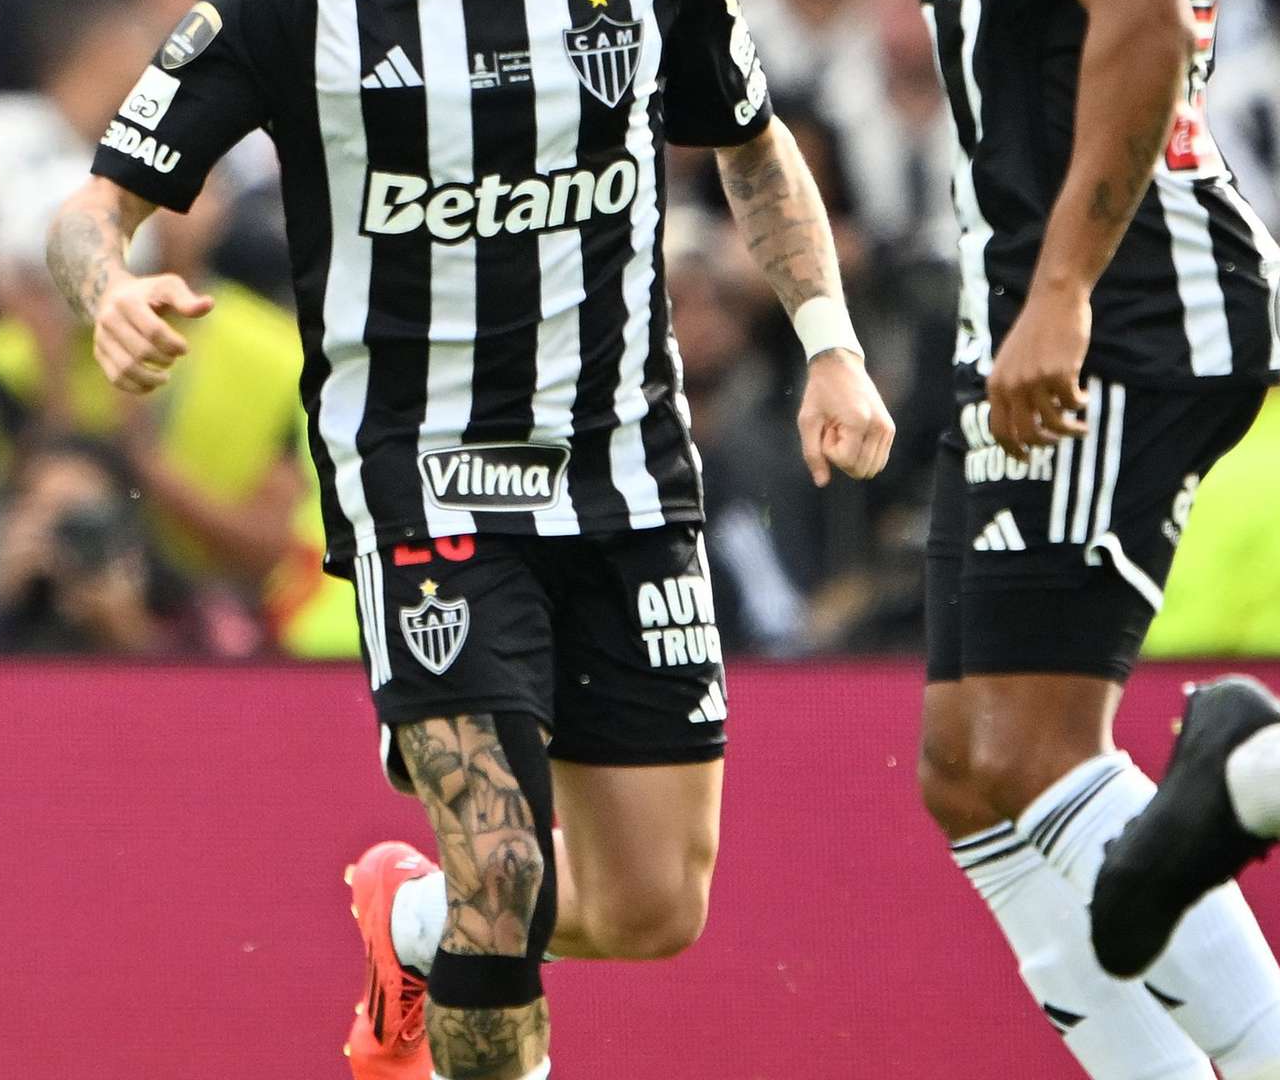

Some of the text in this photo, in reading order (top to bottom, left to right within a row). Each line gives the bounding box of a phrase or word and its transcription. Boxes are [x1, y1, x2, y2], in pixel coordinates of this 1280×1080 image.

[575, 29, 633, 51] CAM
[101, 120, 181, 173] RDAU
[364, 160, 637, 240] Betano
[427, 452, 552, 498] Vilma
[638, 576, 716, 628] AUT
[642, 624, 722, 668] TRUC
